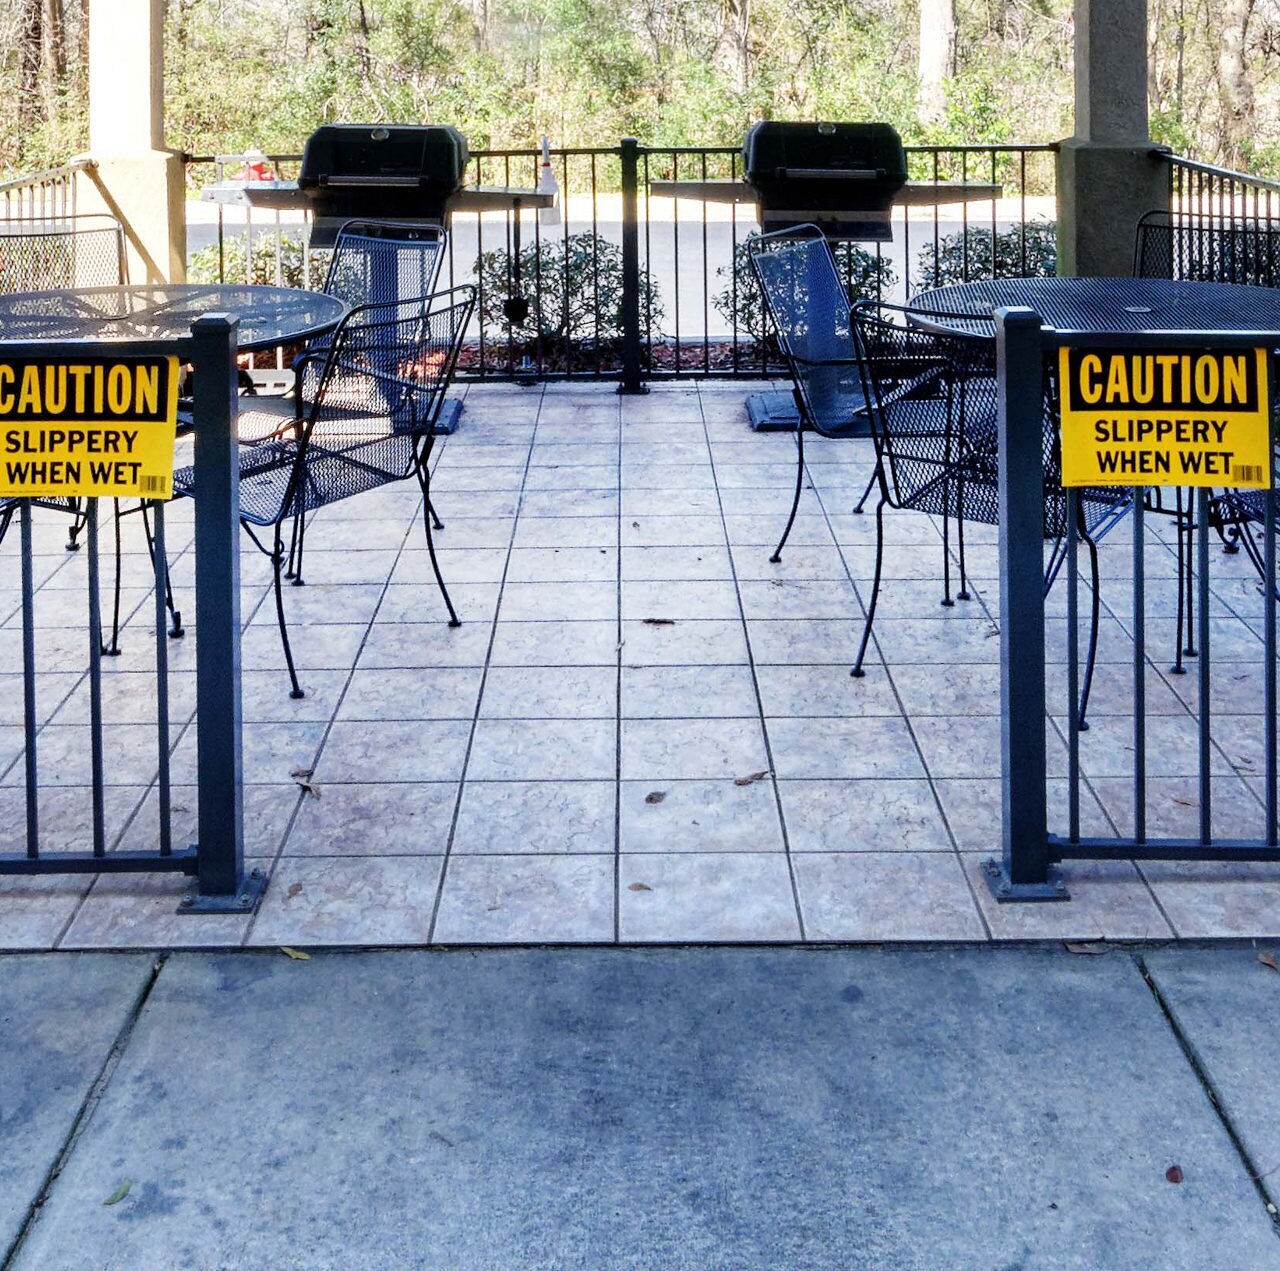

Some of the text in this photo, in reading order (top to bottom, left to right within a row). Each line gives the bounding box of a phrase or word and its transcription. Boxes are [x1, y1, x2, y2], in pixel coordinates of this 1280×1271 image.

[1079, 354, 1247, 405] CAUTION
[5, 430, 139, 453] SLIPPERY
[1094, 419, 1228, 443] SLIPPERY
[6, 461, 142, 485] WHEN WET
[1096, 450, 1234, 475] WHEN WET
